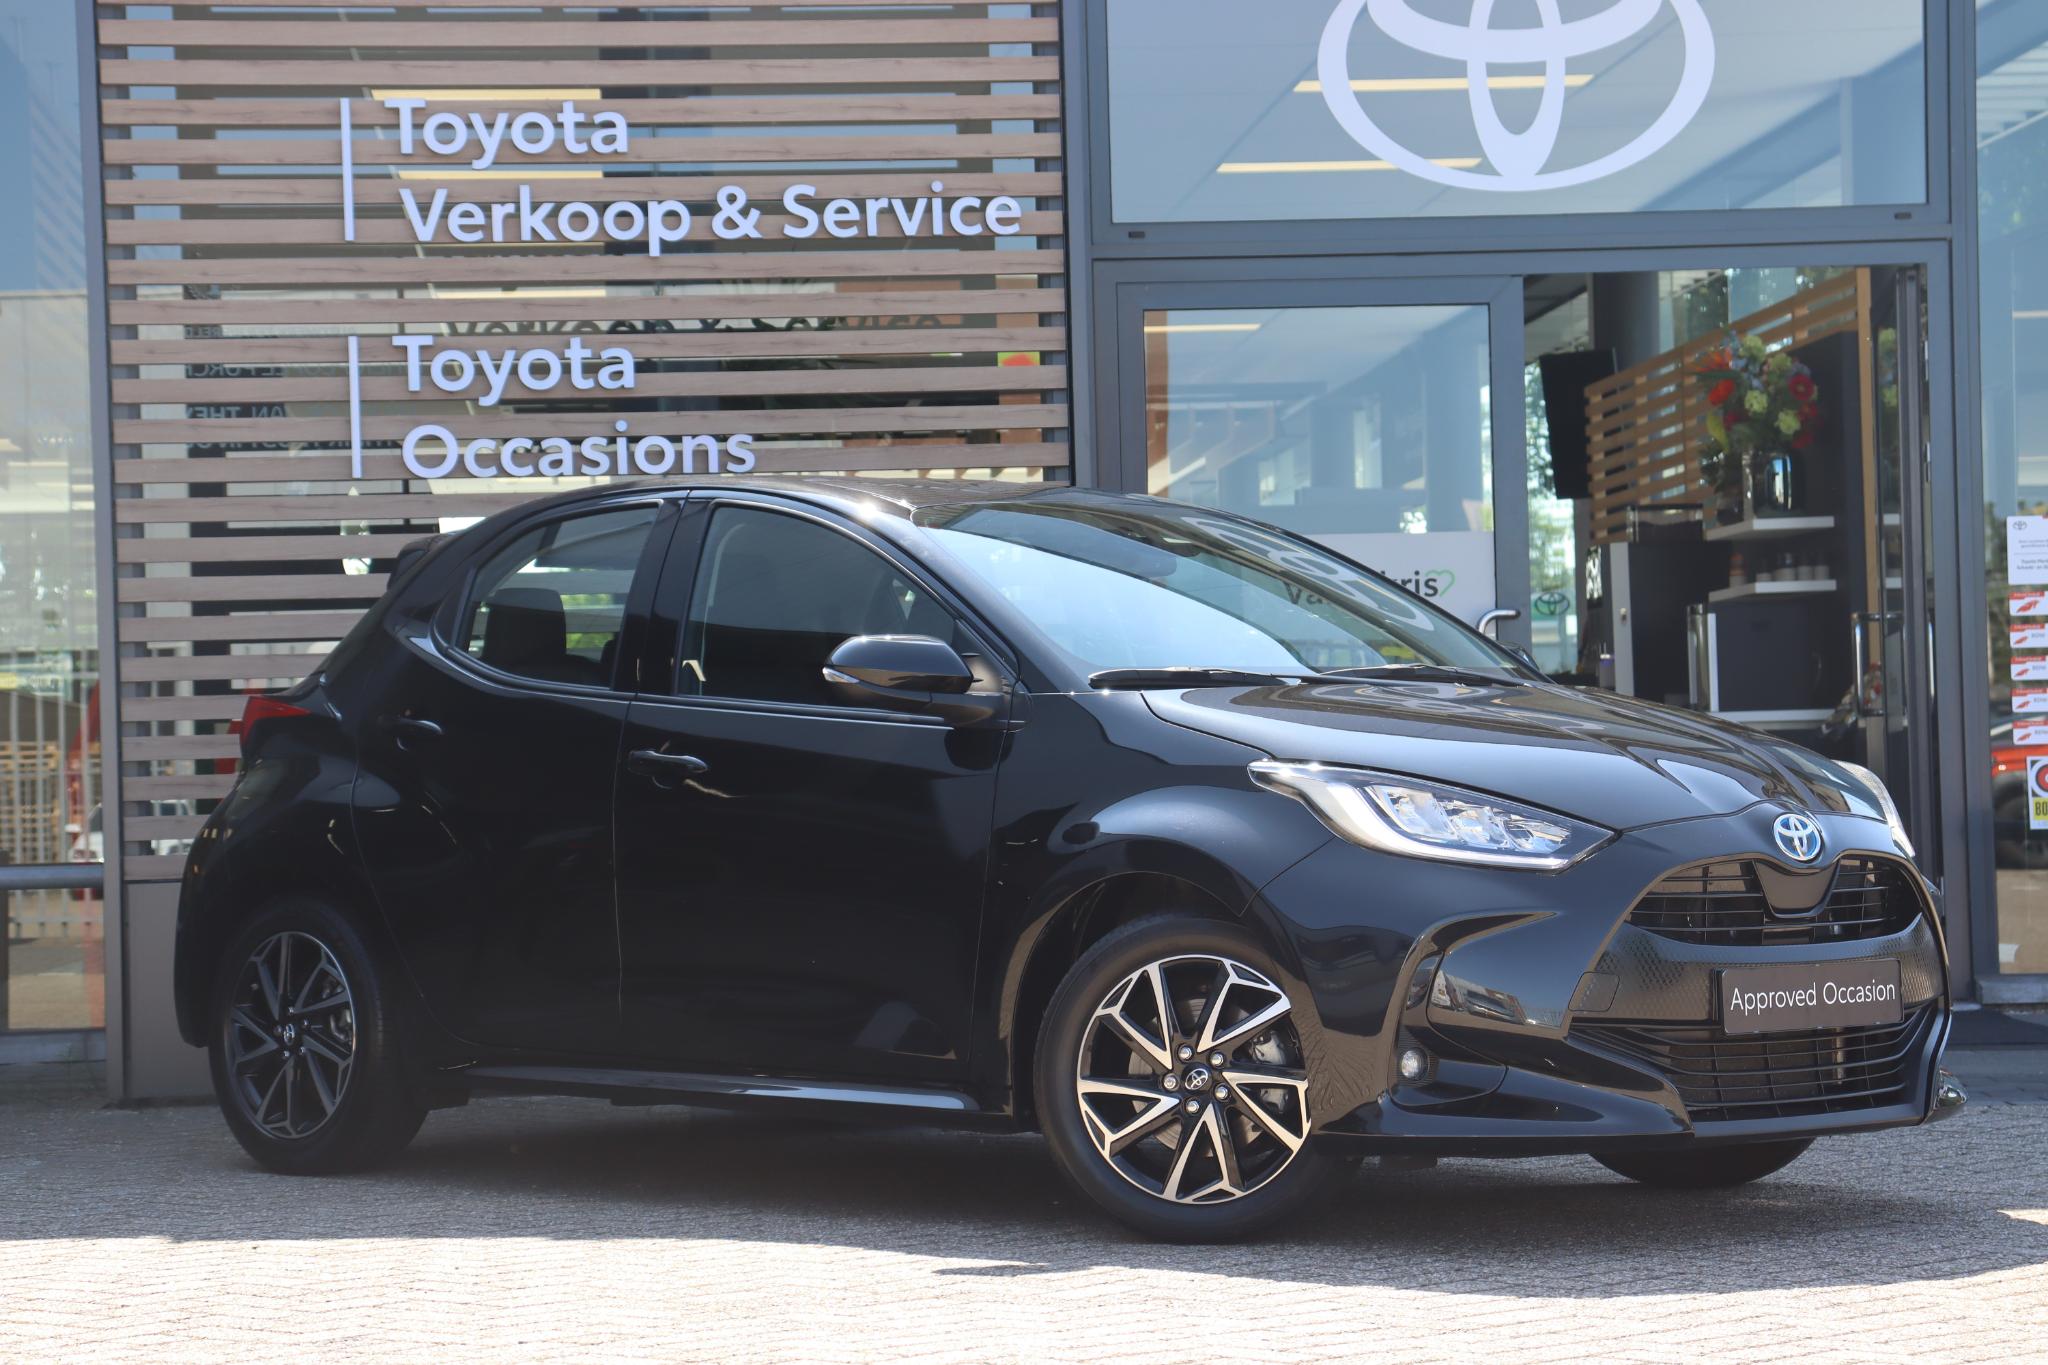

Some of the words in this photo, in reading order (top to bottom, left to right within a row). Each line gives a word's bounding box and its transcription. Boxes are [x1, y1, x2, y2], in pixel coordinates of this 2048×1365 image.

[384, 99, 629, 169] Toyota
[399, 185, 690, 256] Verkoop
[711, 185, 762, 239] &
[783, 181, 1022, 238] Service
[393, 335, 635, 405] Toyota
[403, 420, 755, 478] Occasions
[1730, 982, 1817, 1016] Approved
[1823, 979, 1896, 1005] Occasion
